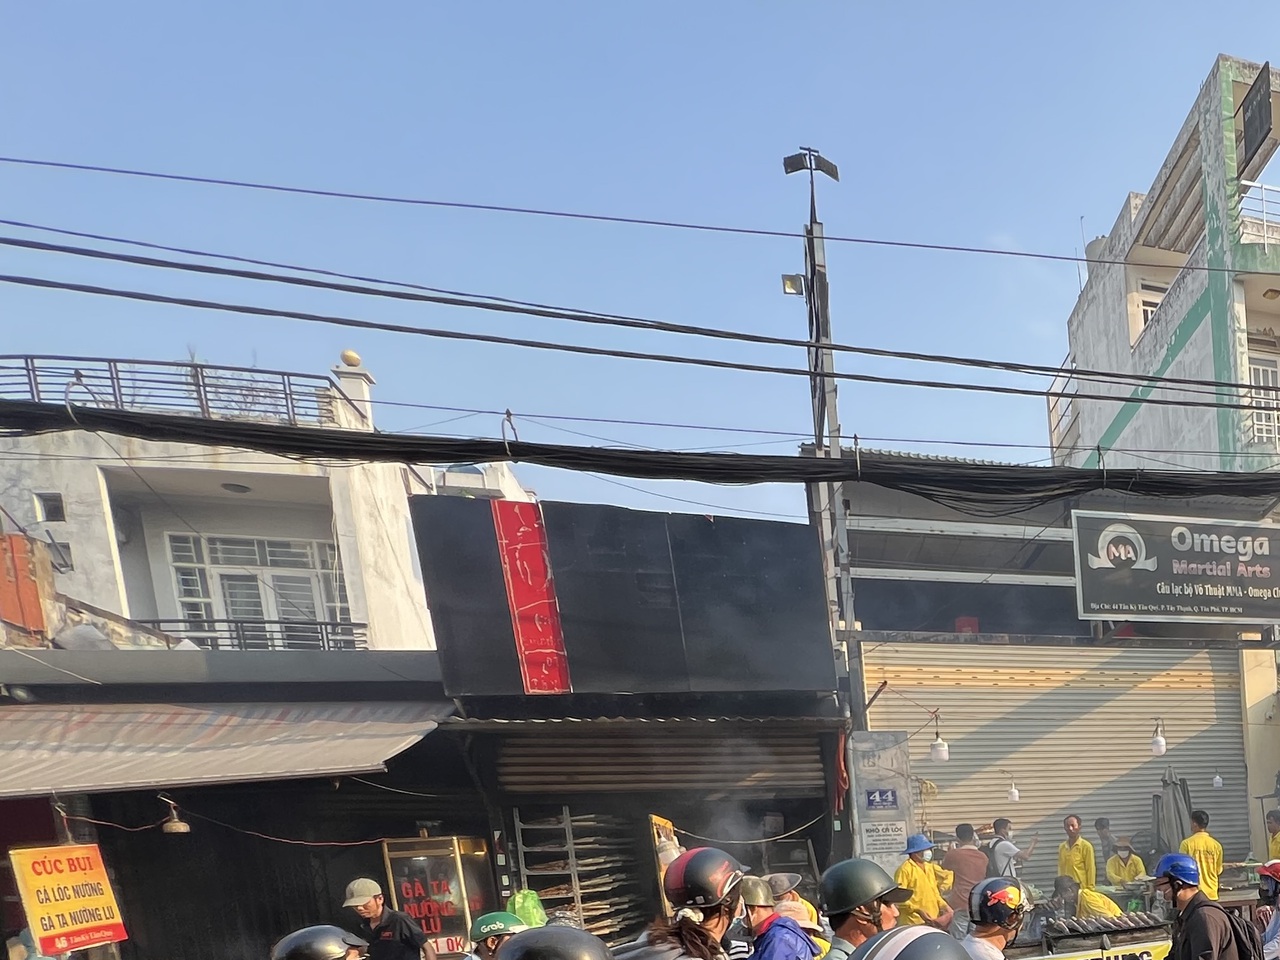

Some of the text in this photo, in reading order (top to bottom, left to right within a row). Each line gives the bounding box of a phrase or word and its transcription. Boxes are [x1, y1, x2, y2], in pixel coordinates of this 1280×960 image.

[1171, 526, 1270, 562] Omega
[1172, 559, 1271, 579] Martial Arts
[1171, 583, 1182, 597] lạc
[1183, 583, 1193, 598] bộ
[1204, 584, 1225, 599] Thuật
[1226, 585, 1243, 597] MMA
[1248, 587, 1272, 600] Omega
[869, 790, 894, 802] 44
[31, 855, 94, 876] CÚC BỤI
[36, 885, 52, 904] CÁ
[53, 883, 71, 902] LÓC
[401, 879, 451, 898] GÀ TA
[40, 912, 55, 931] GÀ
[55, 913, 69, 928] TA
[102, 905, 115, 919] LU
[421, 917, 443, 934] LU
[480, 921, 505, 933] Grab
